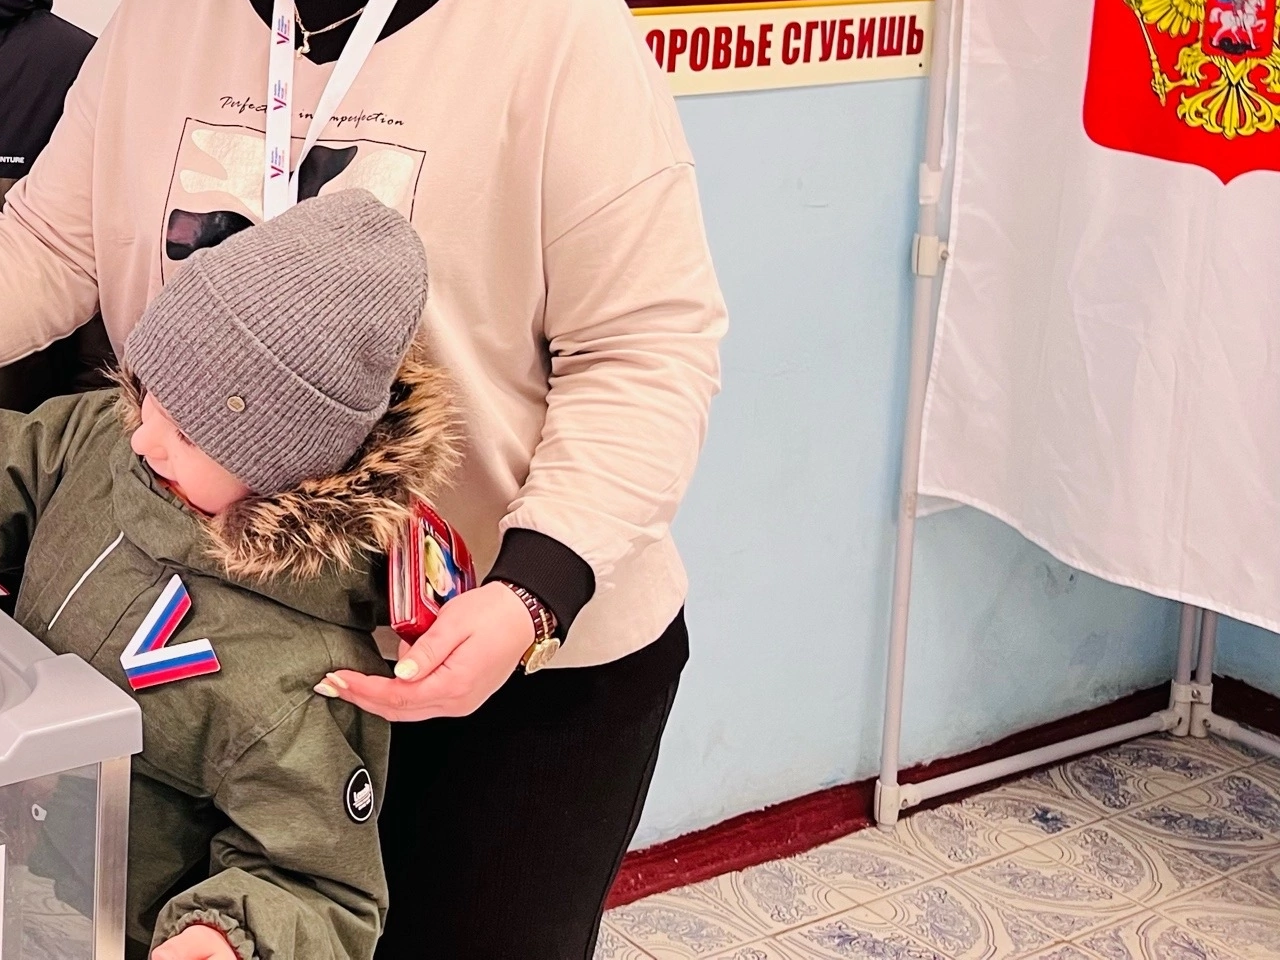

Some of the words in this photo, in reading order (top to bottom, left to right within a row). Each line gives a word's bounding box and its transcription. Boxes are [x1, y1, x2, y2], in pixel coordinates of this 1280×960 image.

[645, 23, 773, 73] ОРОВЬЕ
[781, 15, 924, 66] СГУБИШЬ
[329, 109, 404, 129] mperfection
